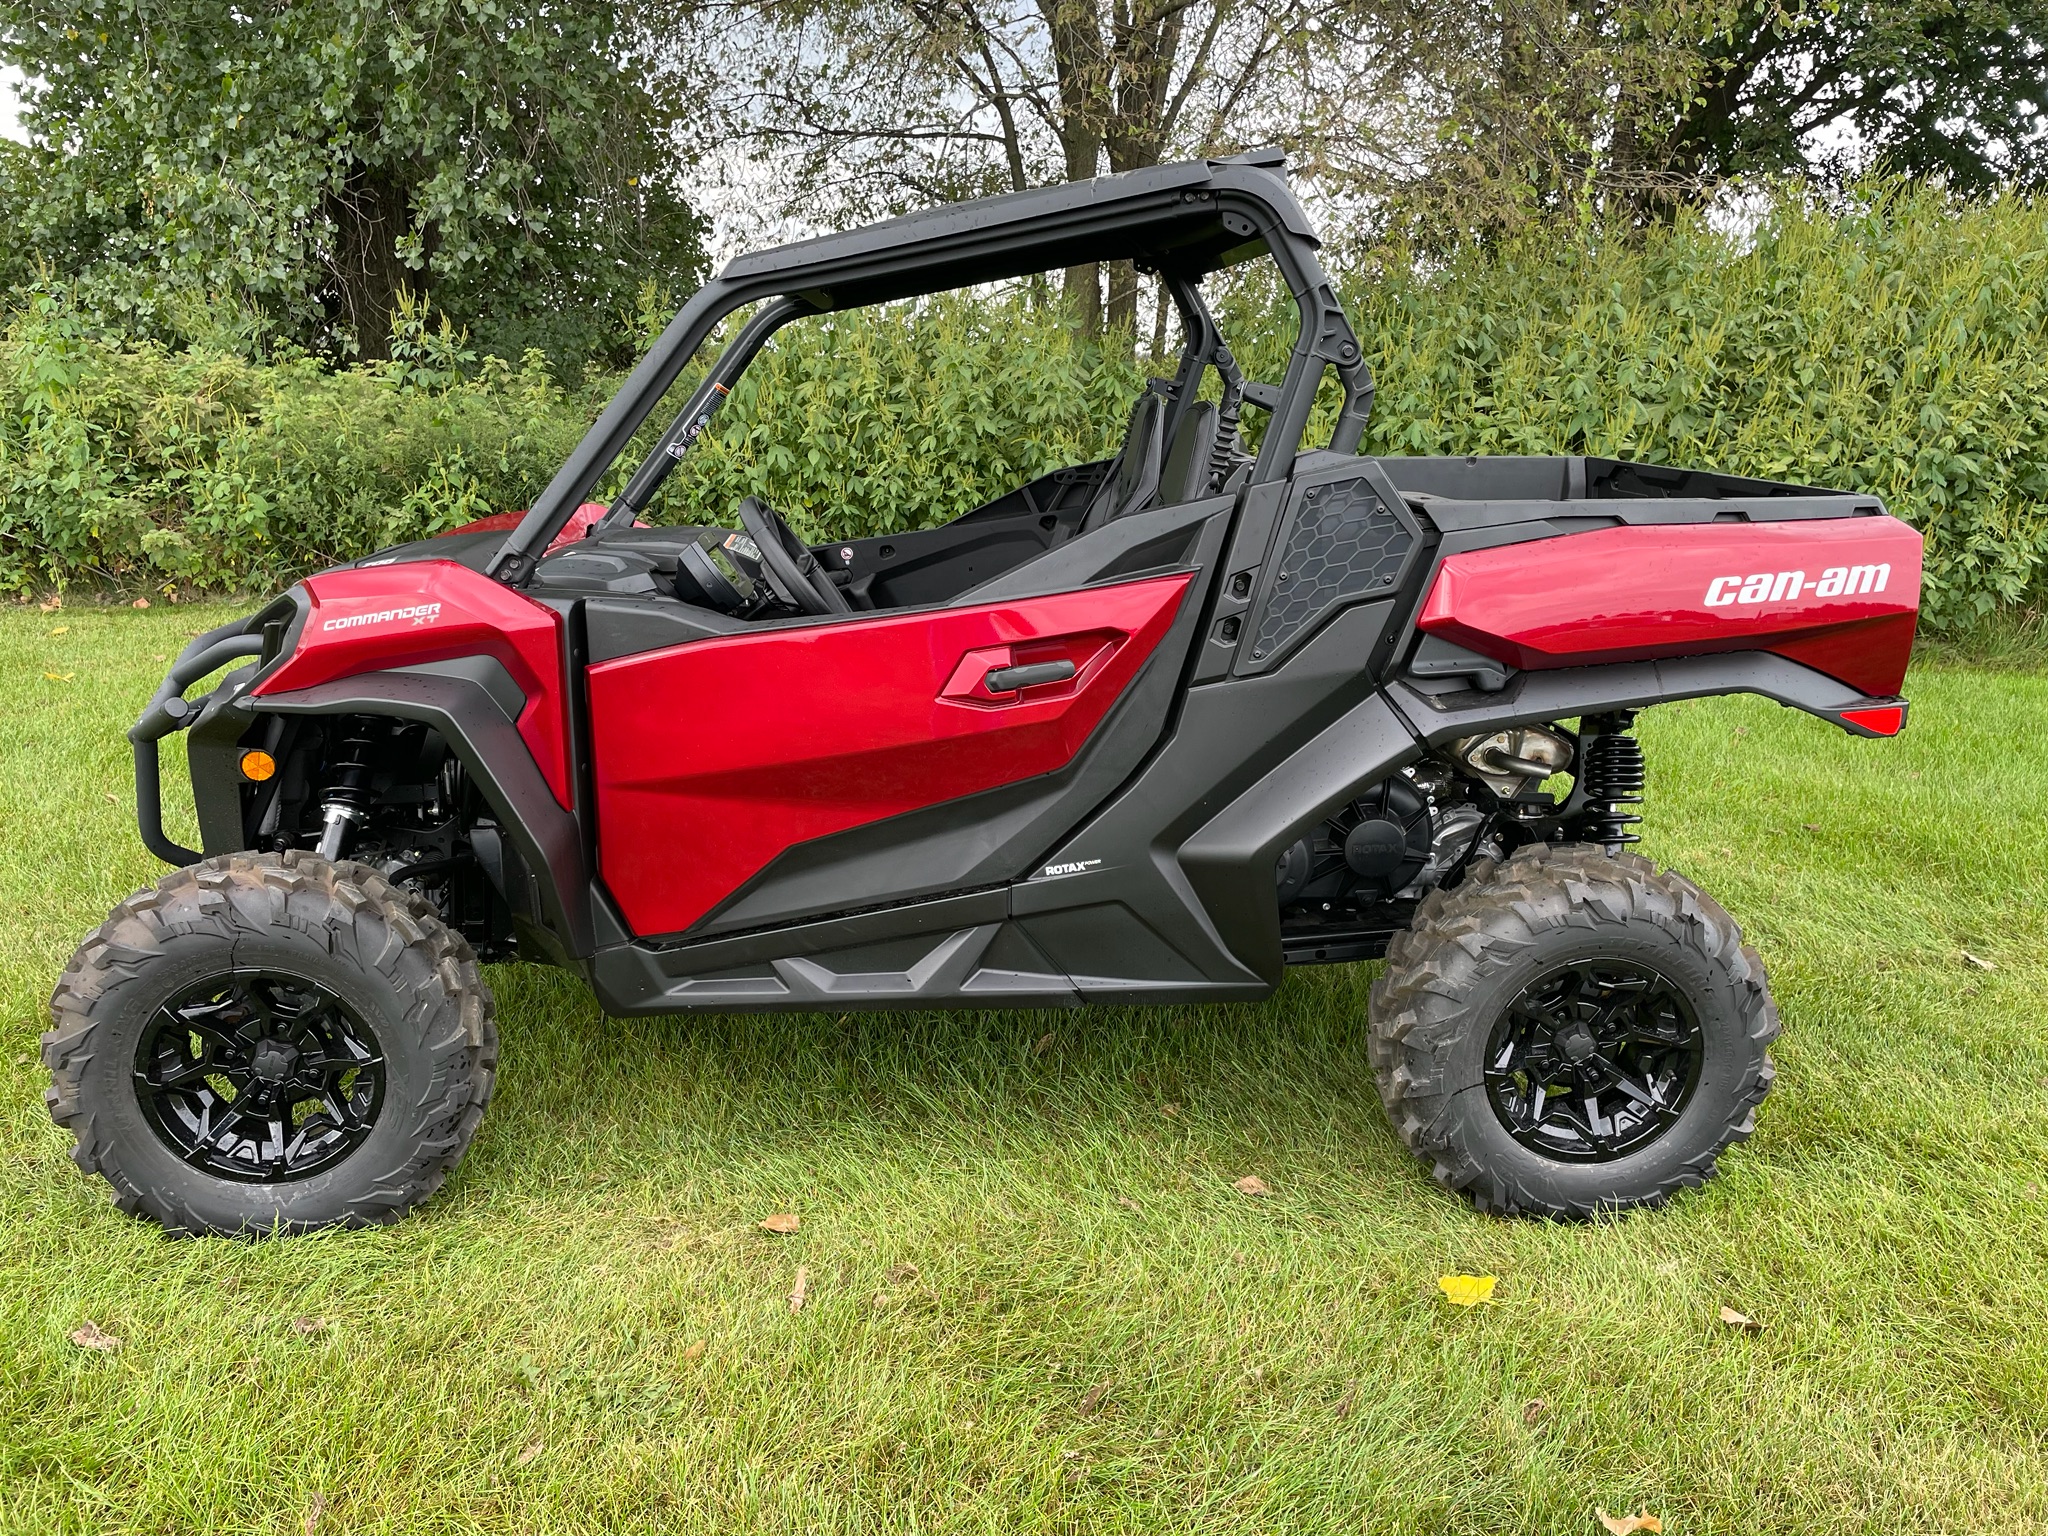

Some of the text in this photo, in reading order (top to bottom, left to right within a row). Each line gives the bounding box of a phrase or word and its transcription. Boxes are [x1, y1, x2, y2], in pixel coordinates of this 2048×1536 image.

[1704, 563, 1891, 607] can-am
[323, 603, 441, 631] COMMANDER
[412, 614, 440, 626] XT
[1351, 843, 1398, 855] ROTAX
[1045, 862, 1086, 876] ROTAX
